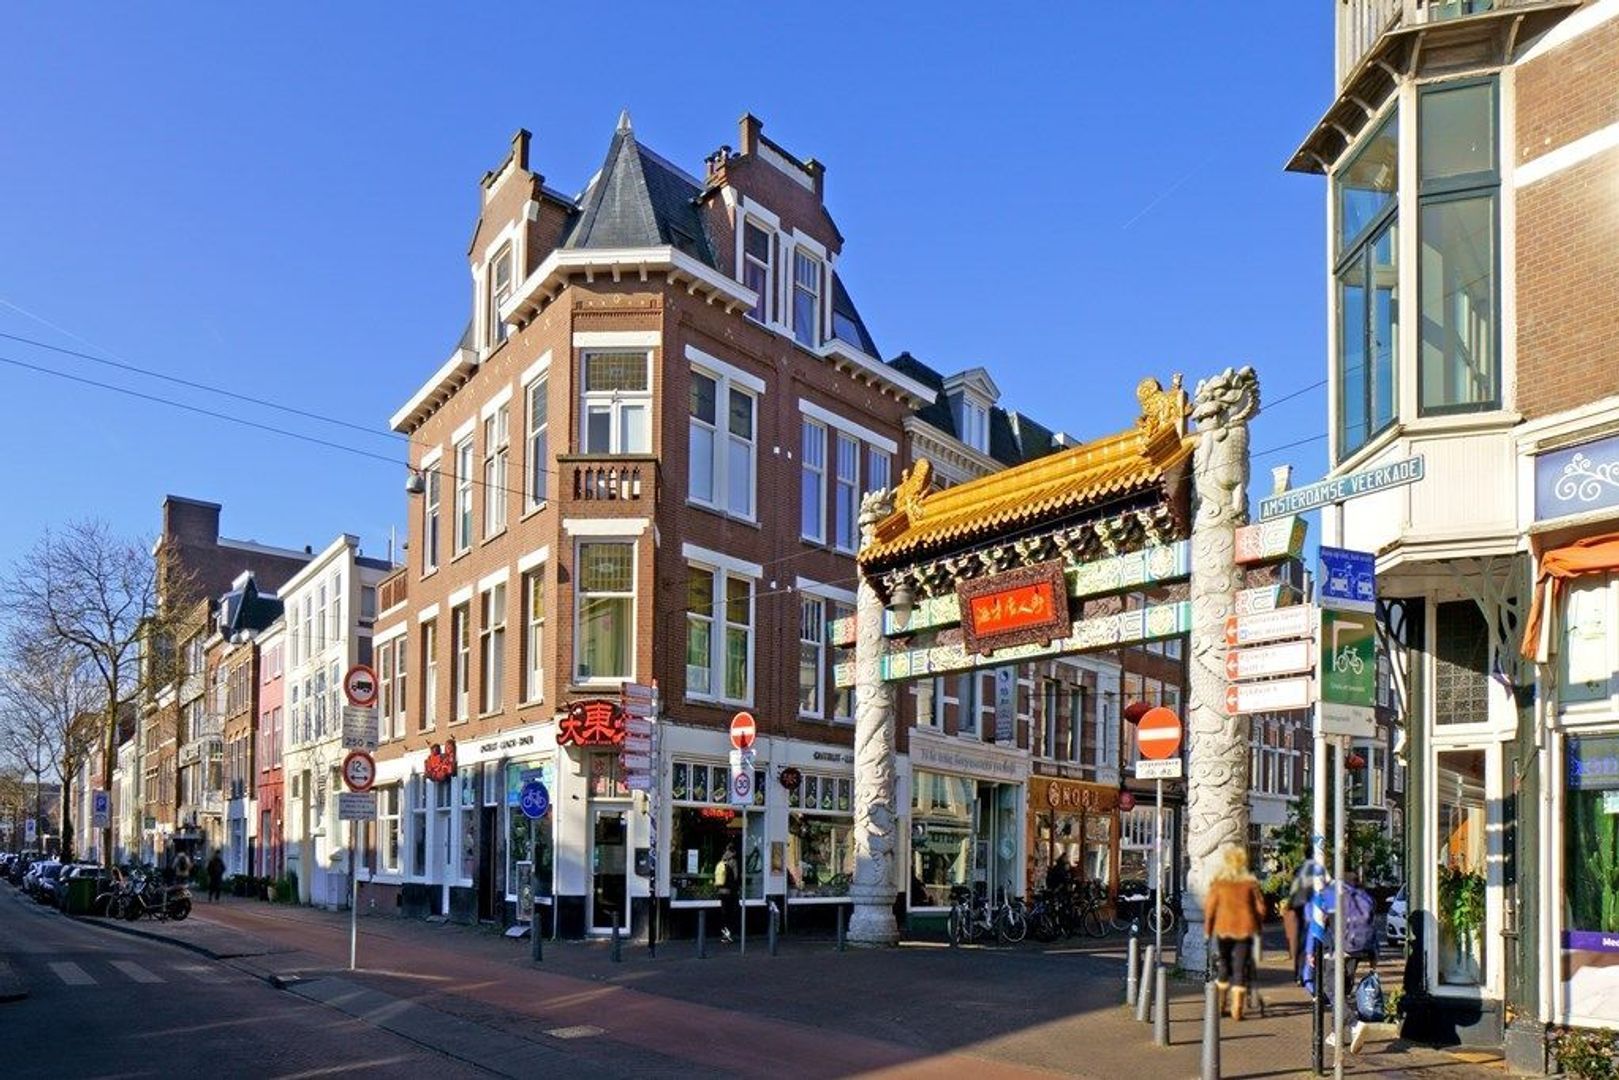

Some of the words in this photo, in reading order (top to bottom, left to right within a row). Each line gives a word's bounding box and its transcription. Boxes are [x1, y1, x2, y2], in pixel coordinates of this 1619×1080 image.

[1262, 481, 1345, 518] AMSTERDAMSE
[1351, 460, 1418, 493] VEERKADE
[345, 737, 364, 747] 250
[738, 778, 748, 789] 30
